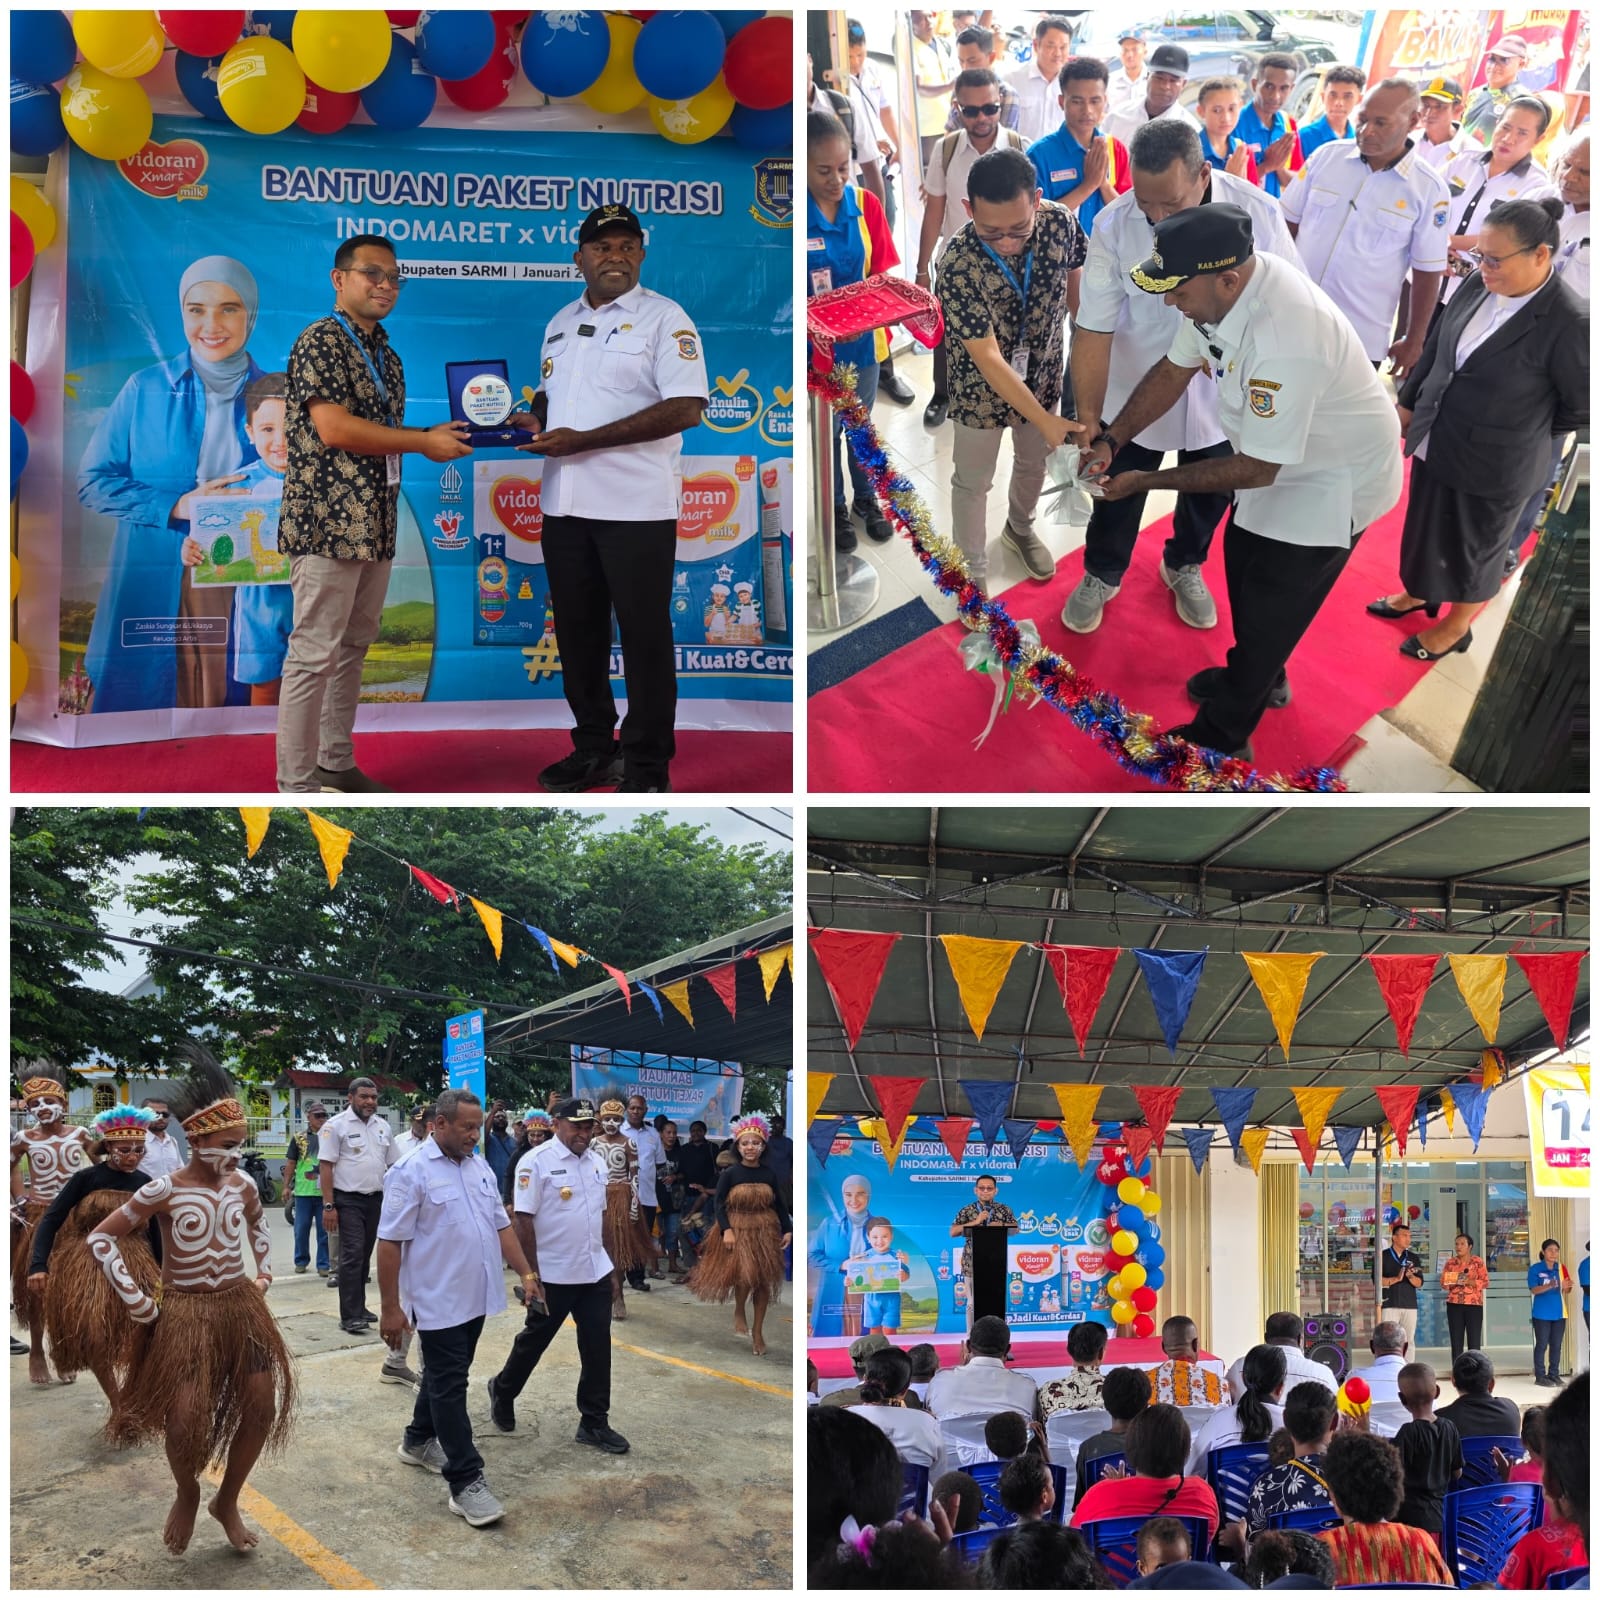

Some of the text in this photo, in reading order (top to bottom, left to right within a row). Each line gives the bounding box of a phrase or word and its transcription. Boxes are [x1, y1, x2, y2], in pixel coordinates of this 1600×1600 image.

[140, 171, 184, 183] Xmart
[180, 187, 205, 198] milk
[263, 166, 720, 213] BANTUAN PAKET NUTRISI
[336, 216, 511, 244] INDOMARET
[518, 229, 535, 244] x
[461, 264, 507, 278] SARMI
[522, 266, 571, 280] Januari
[709, 396, 750, 408] Inulin
[706, 408, 752, 421] 1000mg
[708, 525, 736, 538] milk
[484, 537, 503, 555] 1+
[1550, 1153, 1570, 1164] JAN
[1019, 1255, 1049, 1263] vidoran
